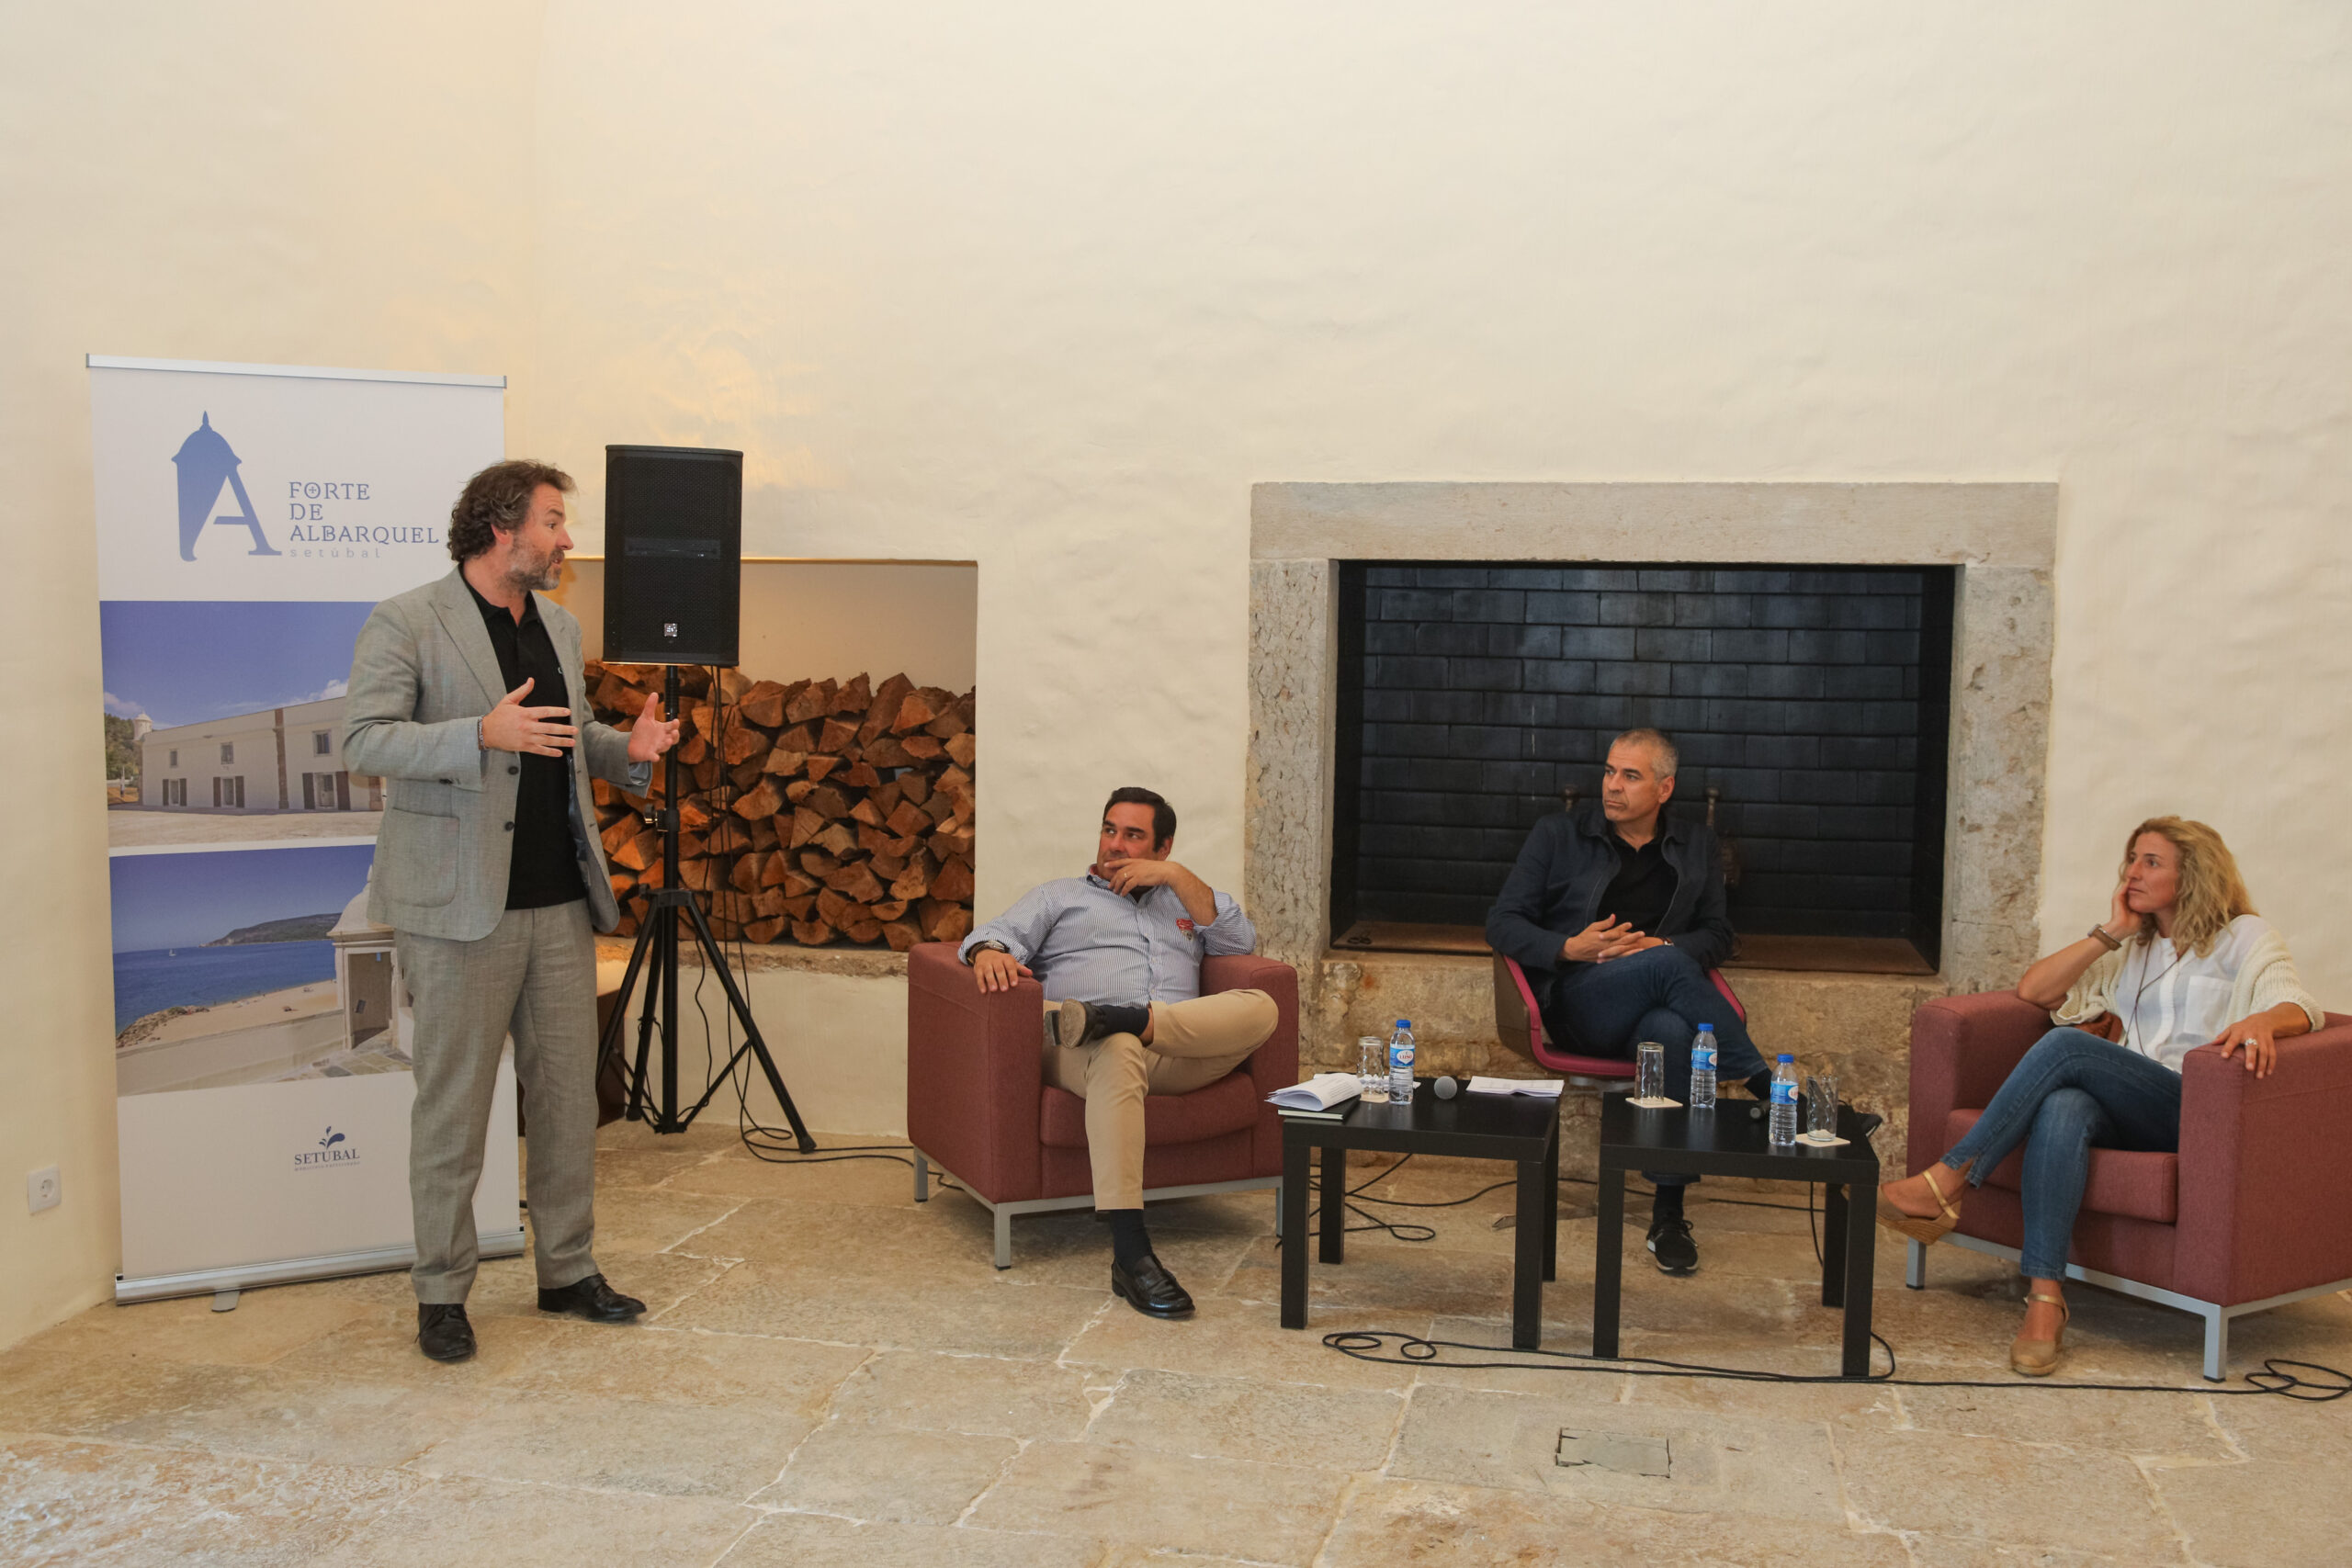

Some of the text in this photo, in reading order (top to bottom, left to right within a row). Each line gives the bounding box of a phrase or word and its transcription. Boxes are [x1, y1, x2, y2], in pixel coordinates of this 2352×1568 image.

[288, 481, 370, 501] FORTE
[288, 503, 323, 521] DE
[288, 525, 440, 545] ALBARQUEL
